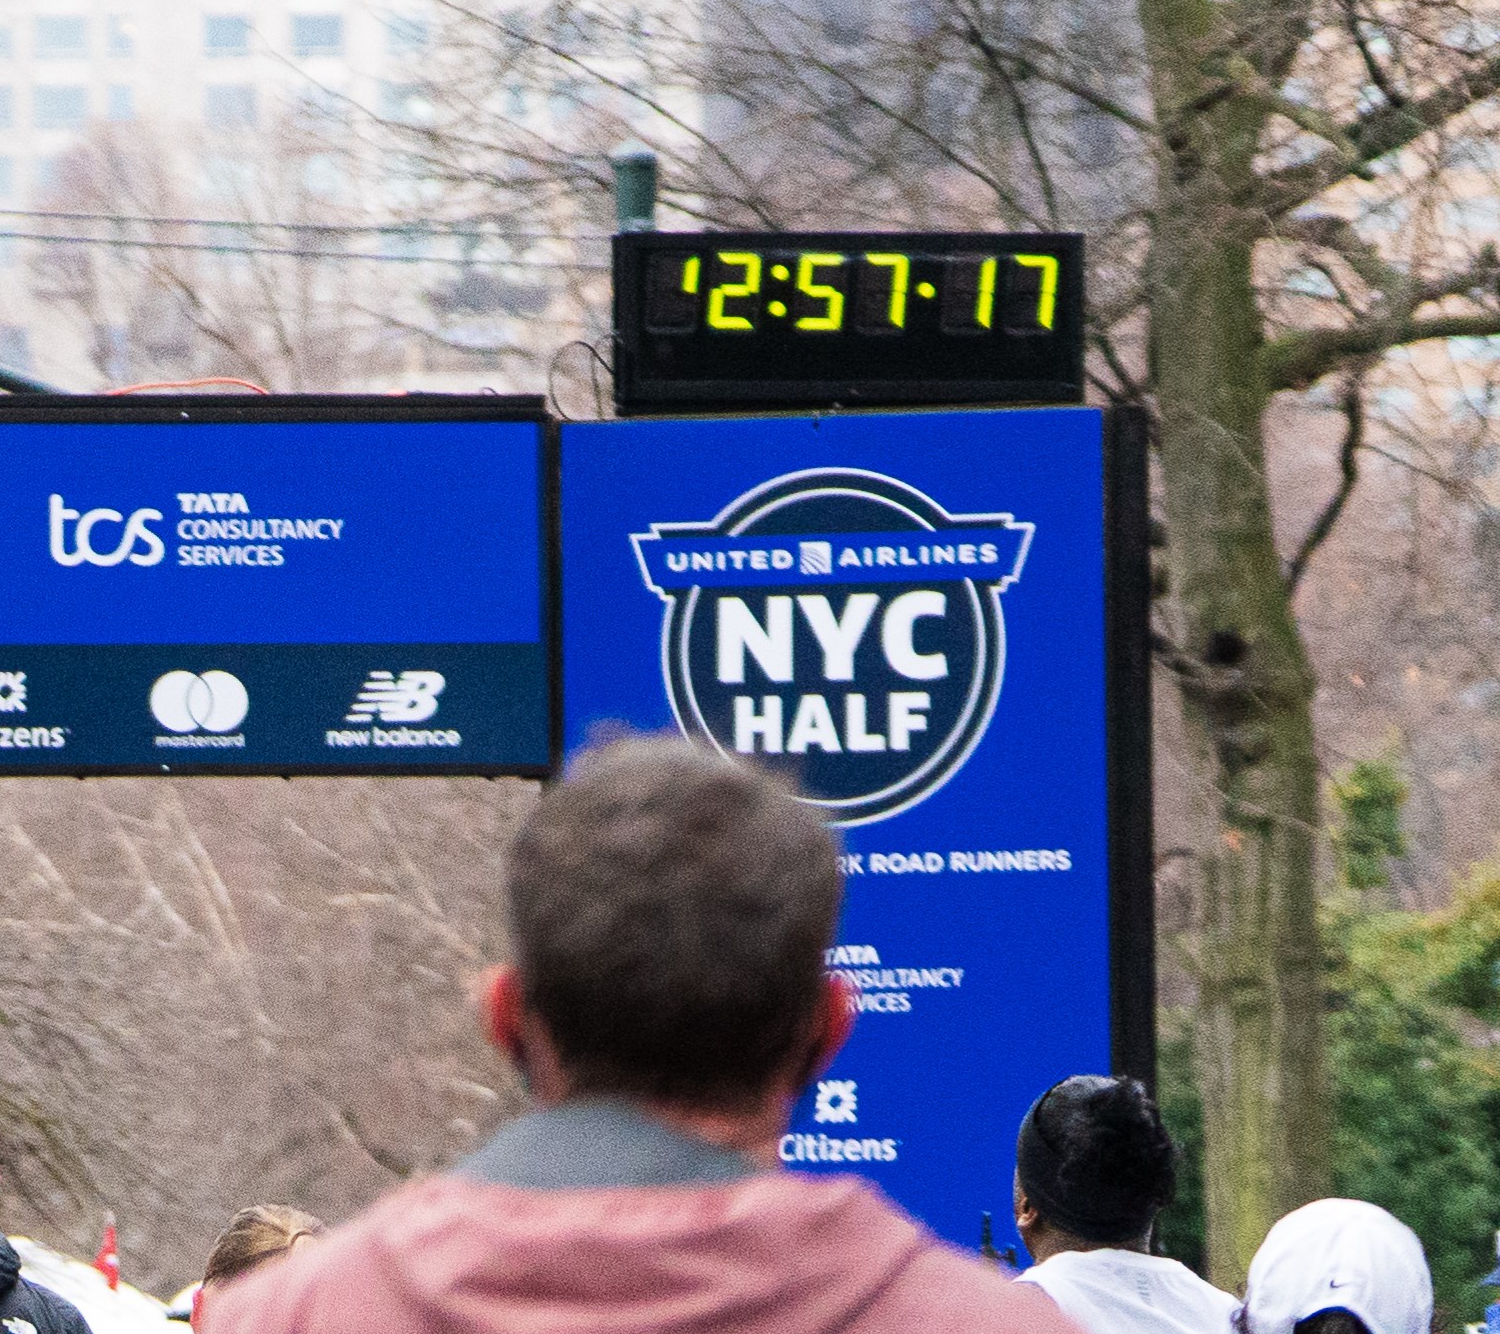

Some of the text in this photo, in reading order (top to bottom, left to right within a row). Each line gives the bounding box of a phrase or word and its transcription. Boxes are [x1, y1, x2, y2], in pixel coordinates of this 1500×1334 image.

[177, 493, 249, 513] TATA
[50, 494, 164, 566] tcs
[178, 519, 342, 539] CONSULTANCY
[178, 545, 284, 566] SERVICES
[668, 544, 997, 571] UNITED AIRLINES
[717, 591, 947, 683] NYC
[734, 692, 931, 754] HALF
[156, 735, 244, 747] mastercard
[327, 727, 461, 746] new balance
[870, 853, 944, 873] ROAD
[950, 850, 1071, 872] RUNNERS
[780, 1134, 897, 1162] Citizens
